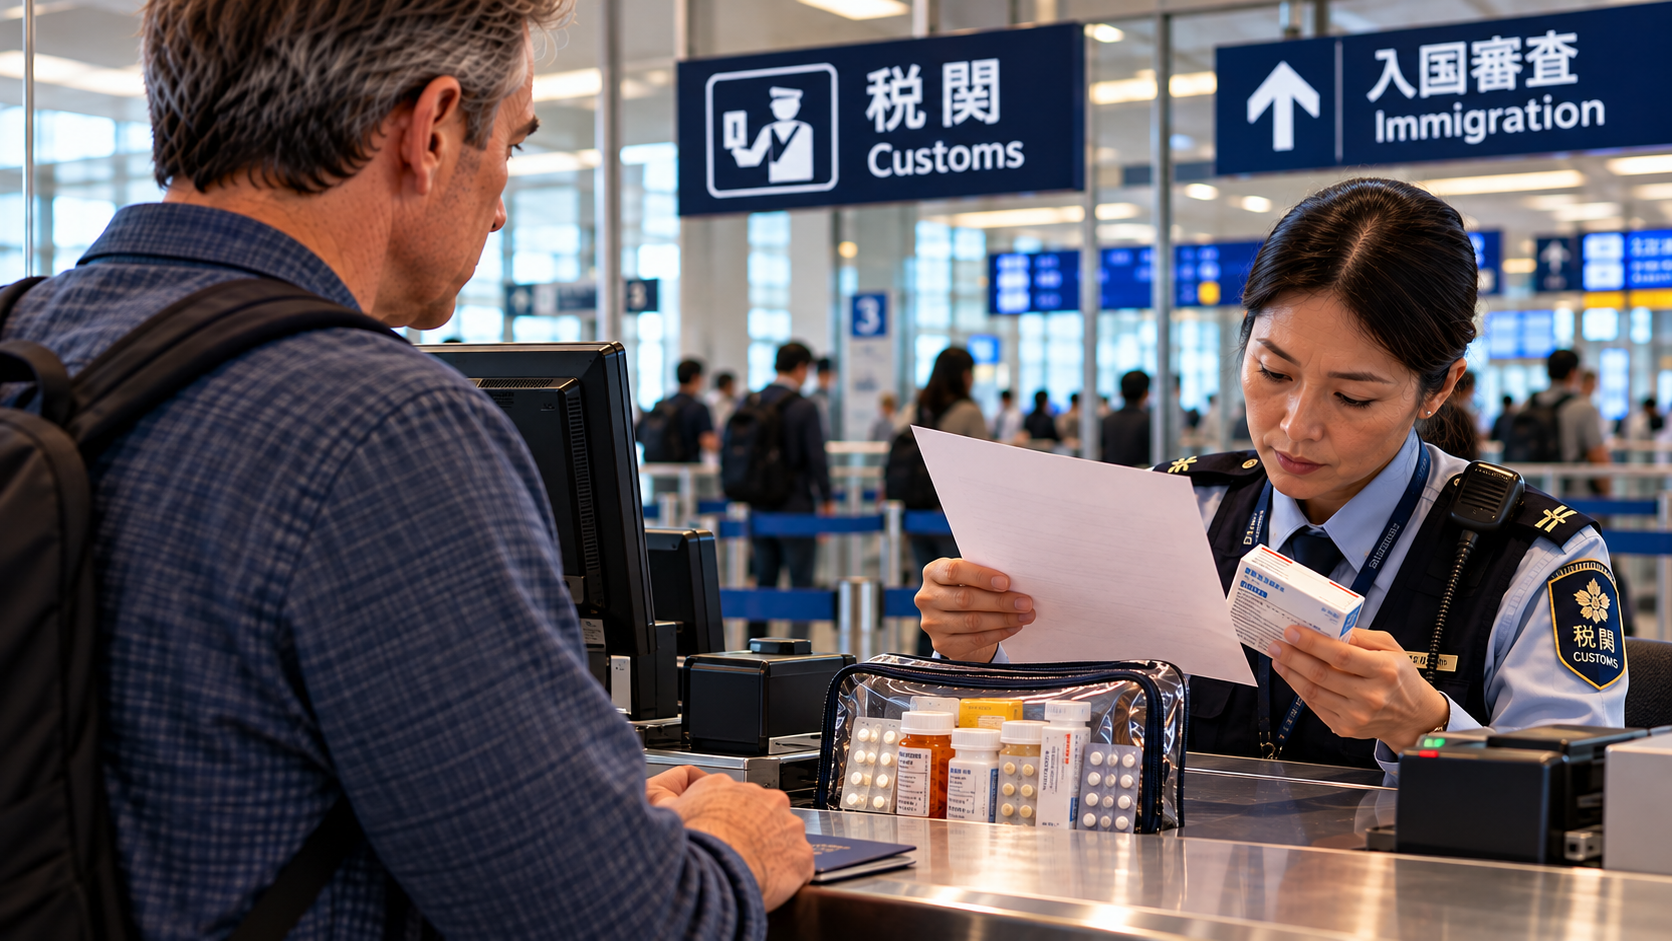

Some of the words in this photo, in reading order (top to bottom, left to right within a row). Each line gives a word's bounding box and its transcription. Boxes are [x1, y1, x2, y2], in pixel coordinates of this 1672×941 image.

[1366, 30, 1579, 103] 入国審査
[865, 57, 1001, 133] 税関
[1375, 94, 1606, 145] Immigration
[867, 140, 1026, 178] Customs
[855, 296, 881, 334] 3
[1573, 624, 1616, 654] 税関
[1573, 651, 1619, 669] CUSTOMS
